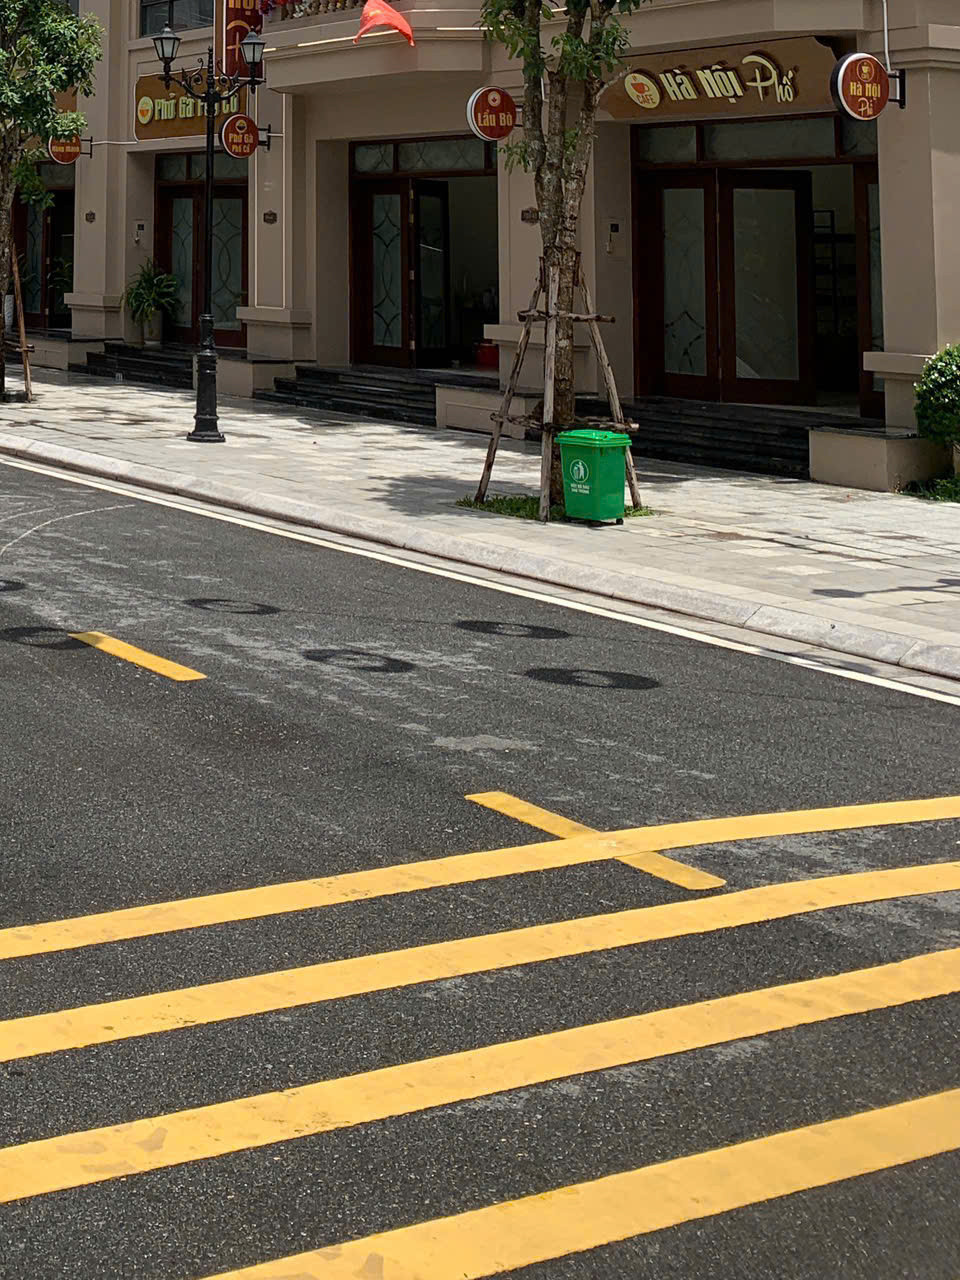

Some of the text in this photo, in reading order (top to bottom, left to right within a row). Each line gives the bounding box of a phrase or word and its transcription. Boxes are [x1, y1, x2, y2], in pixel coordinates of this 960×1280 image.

[659, 55, 794, 103] Hà Nội Phố
[850, 81, 881, 100] Hà Nội
[499, 111, 513, 126] Bò
